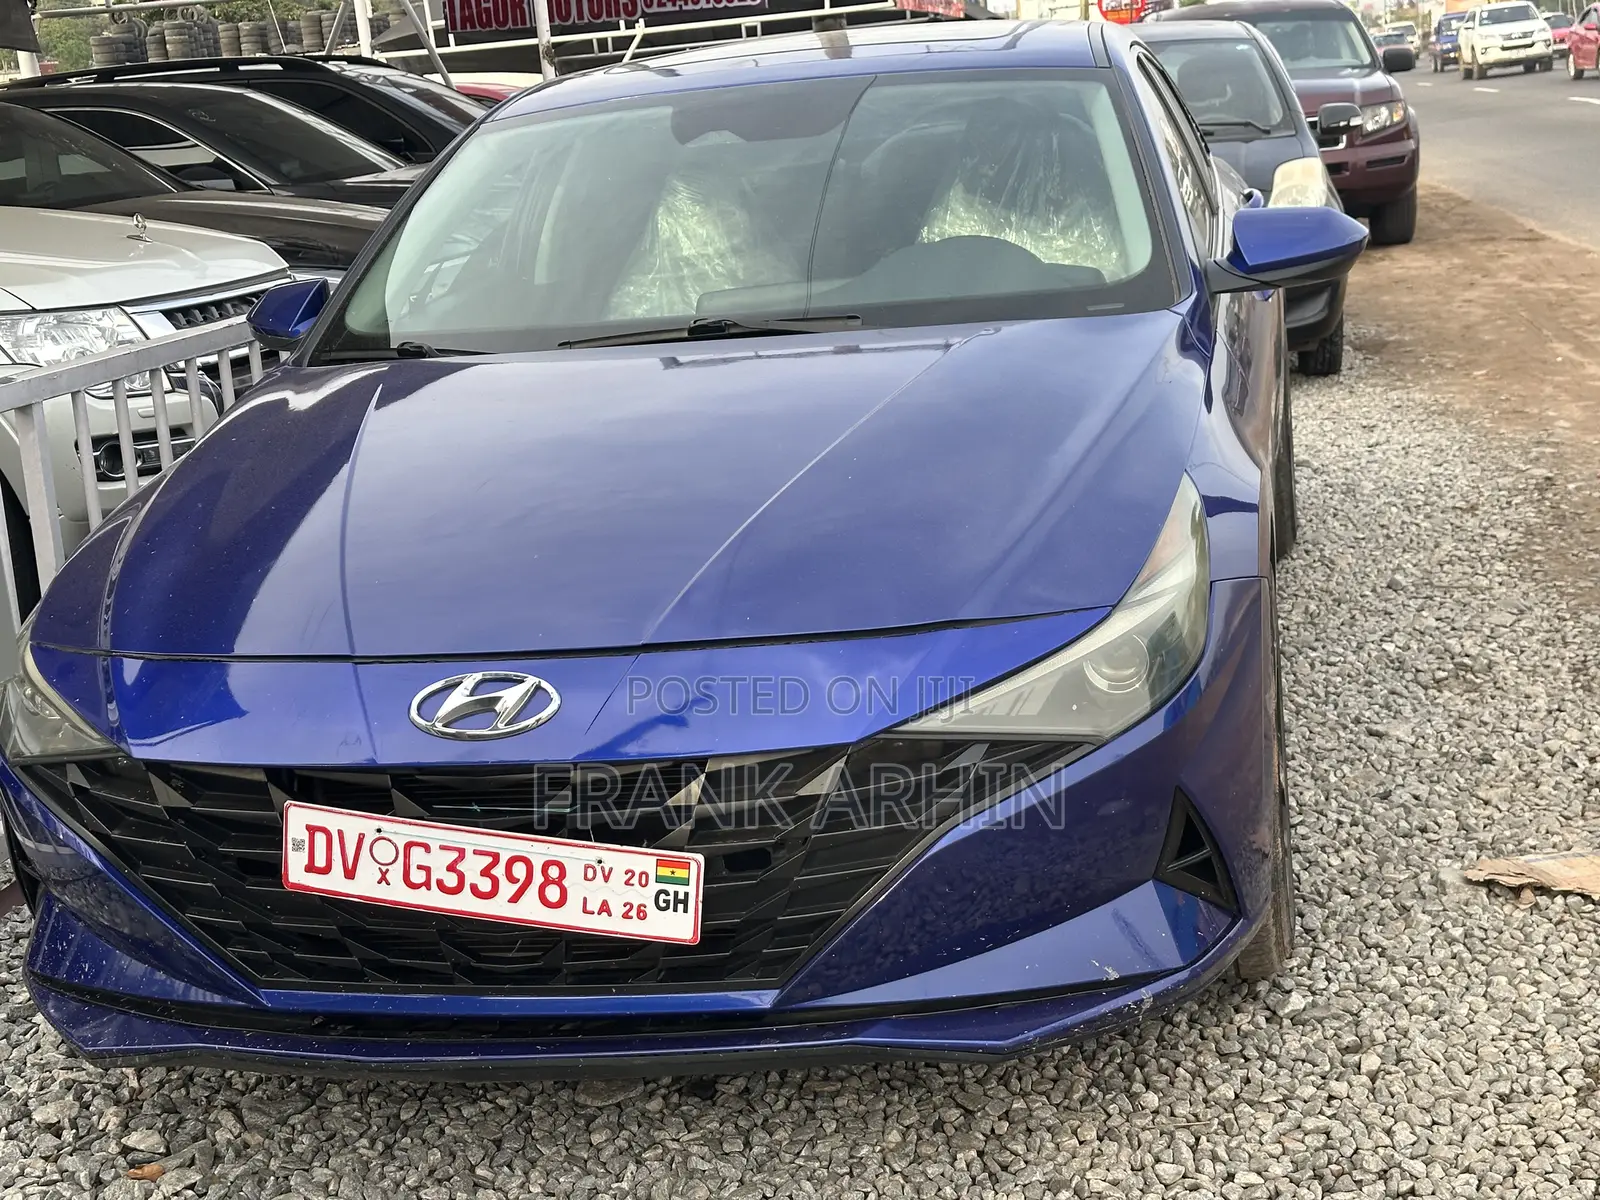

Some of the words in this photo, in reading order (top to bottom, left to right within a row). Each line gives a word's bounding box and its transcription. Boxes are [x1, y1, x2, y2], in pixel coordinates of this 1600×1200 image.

[534, 0, 638, 24] OTORS
[304, 823, 365, 880] DV
[402, 840, 567, 910] G3398
[377, 867, 391, 886] X
[583, 863, 613, 883] DV
[624, 868, 650, 888] 20
[582, 896, 613, 917] LA
[621, 901, 648, 921] 26
[654, 888, 690, 914] GH
